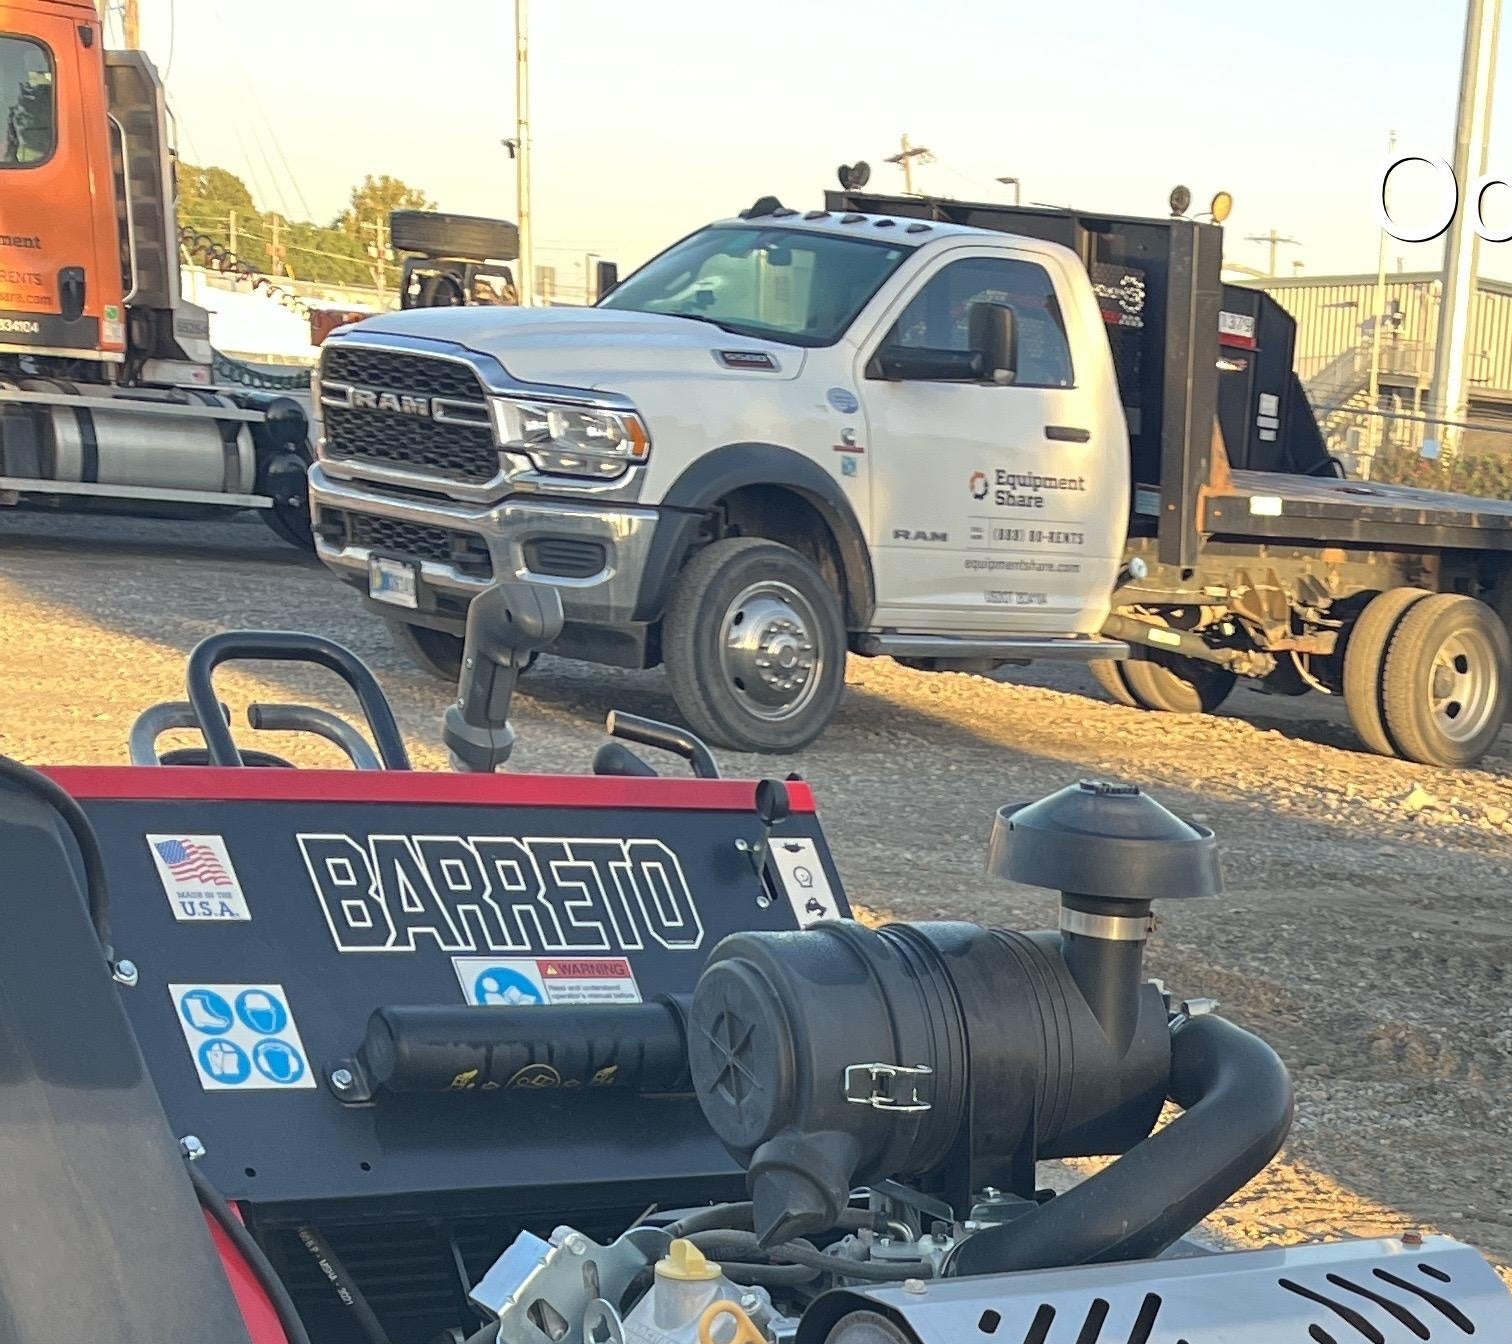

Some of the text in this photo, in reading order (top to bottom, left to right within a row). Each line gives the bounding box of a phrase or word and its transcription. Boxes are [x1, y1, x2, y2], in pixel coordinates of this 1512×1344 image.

[351, 387, 430, 417] RAM
[994, 469, 1087, 492] Equipment
[994, 489, 1044, 508] Share
[893, 529, 948, 542] RAM
[176, 891, 203, 899] MADE
[205, 891, 215, 899] IN
[296, 833, 705, 953] BARRETO
[179, 901, 240, 917] U.S.A.
[558, 963, 625, 976] WARNING
